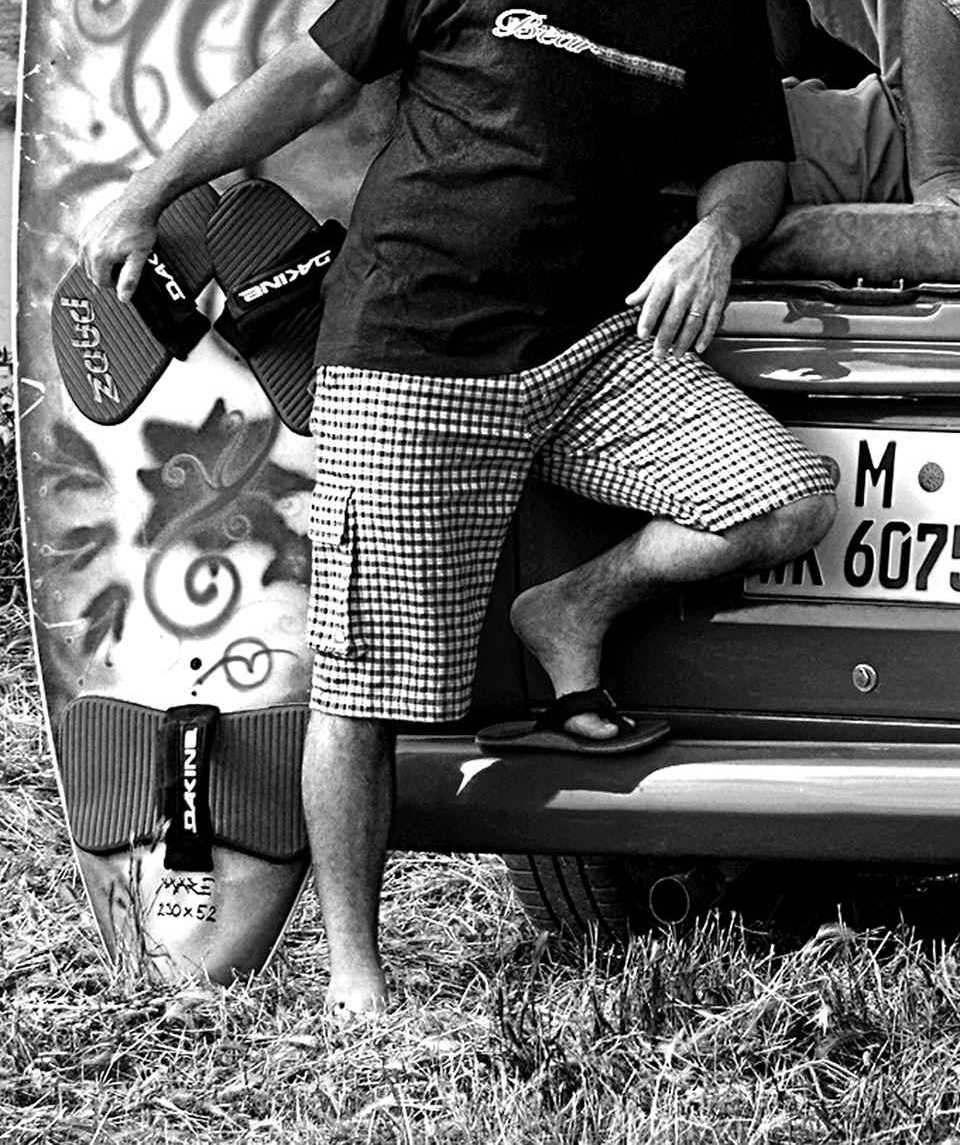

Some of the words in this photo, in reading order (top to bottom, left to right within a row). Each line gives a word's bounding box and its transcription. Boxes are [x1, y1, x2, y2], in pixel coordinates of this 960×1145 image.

[238, 250, 331, 302] DAKINE
[855, 440, 896, 509] M
[184, 727, 198, 834] DAKINE
